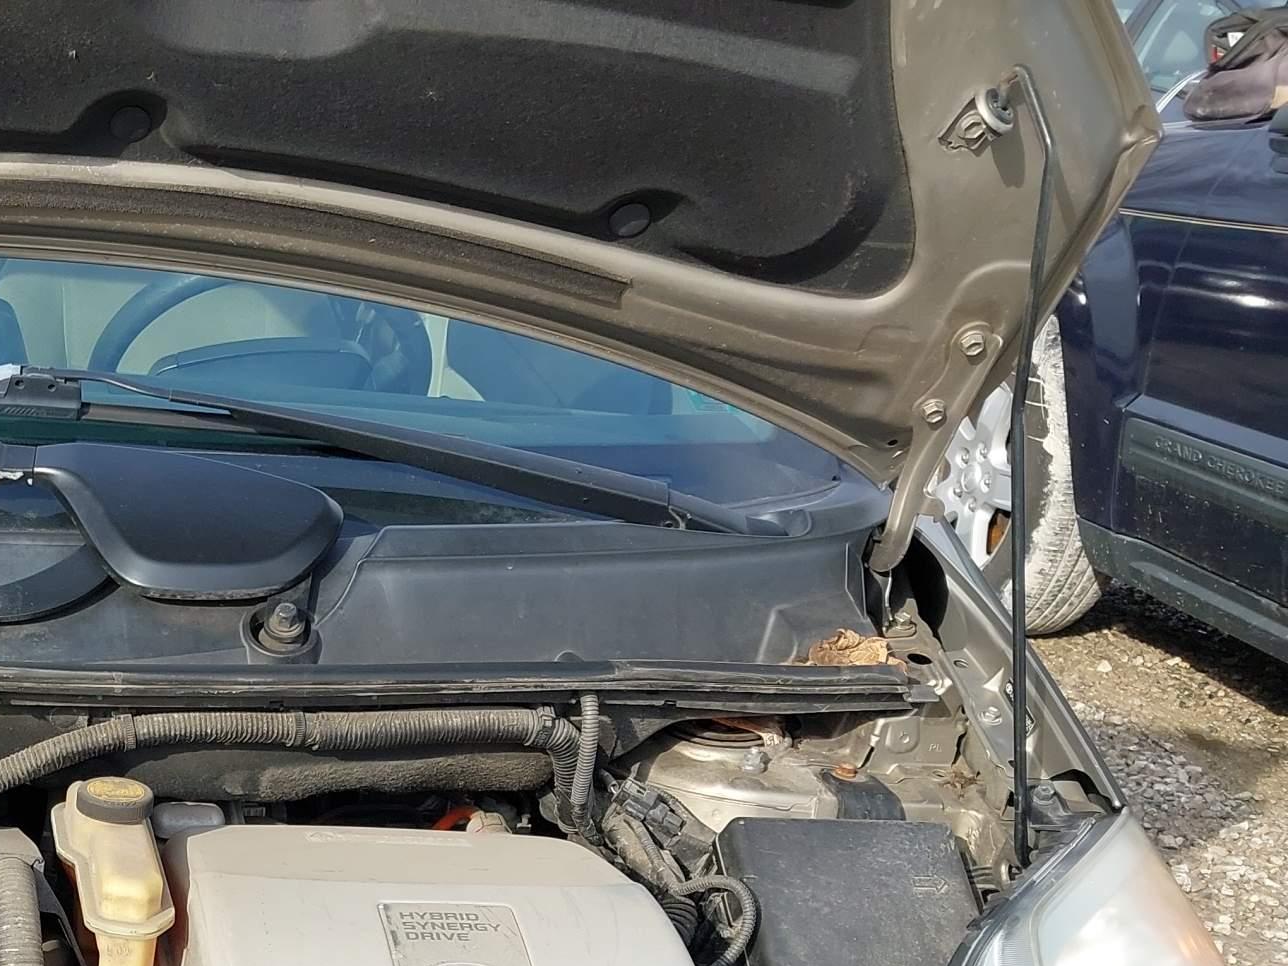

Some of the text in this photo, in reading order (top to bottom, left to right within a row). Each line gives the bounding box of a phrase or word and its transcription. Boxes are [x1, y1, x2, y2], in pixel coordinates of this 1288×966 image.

[1155, 436, 1286, 494] GRAND CHEROKEE
[399, 911, 479, 921] HYBRID
[402, 921, 501, 932] SYNERGY
[405, 931, 471, 941] DRIVE
